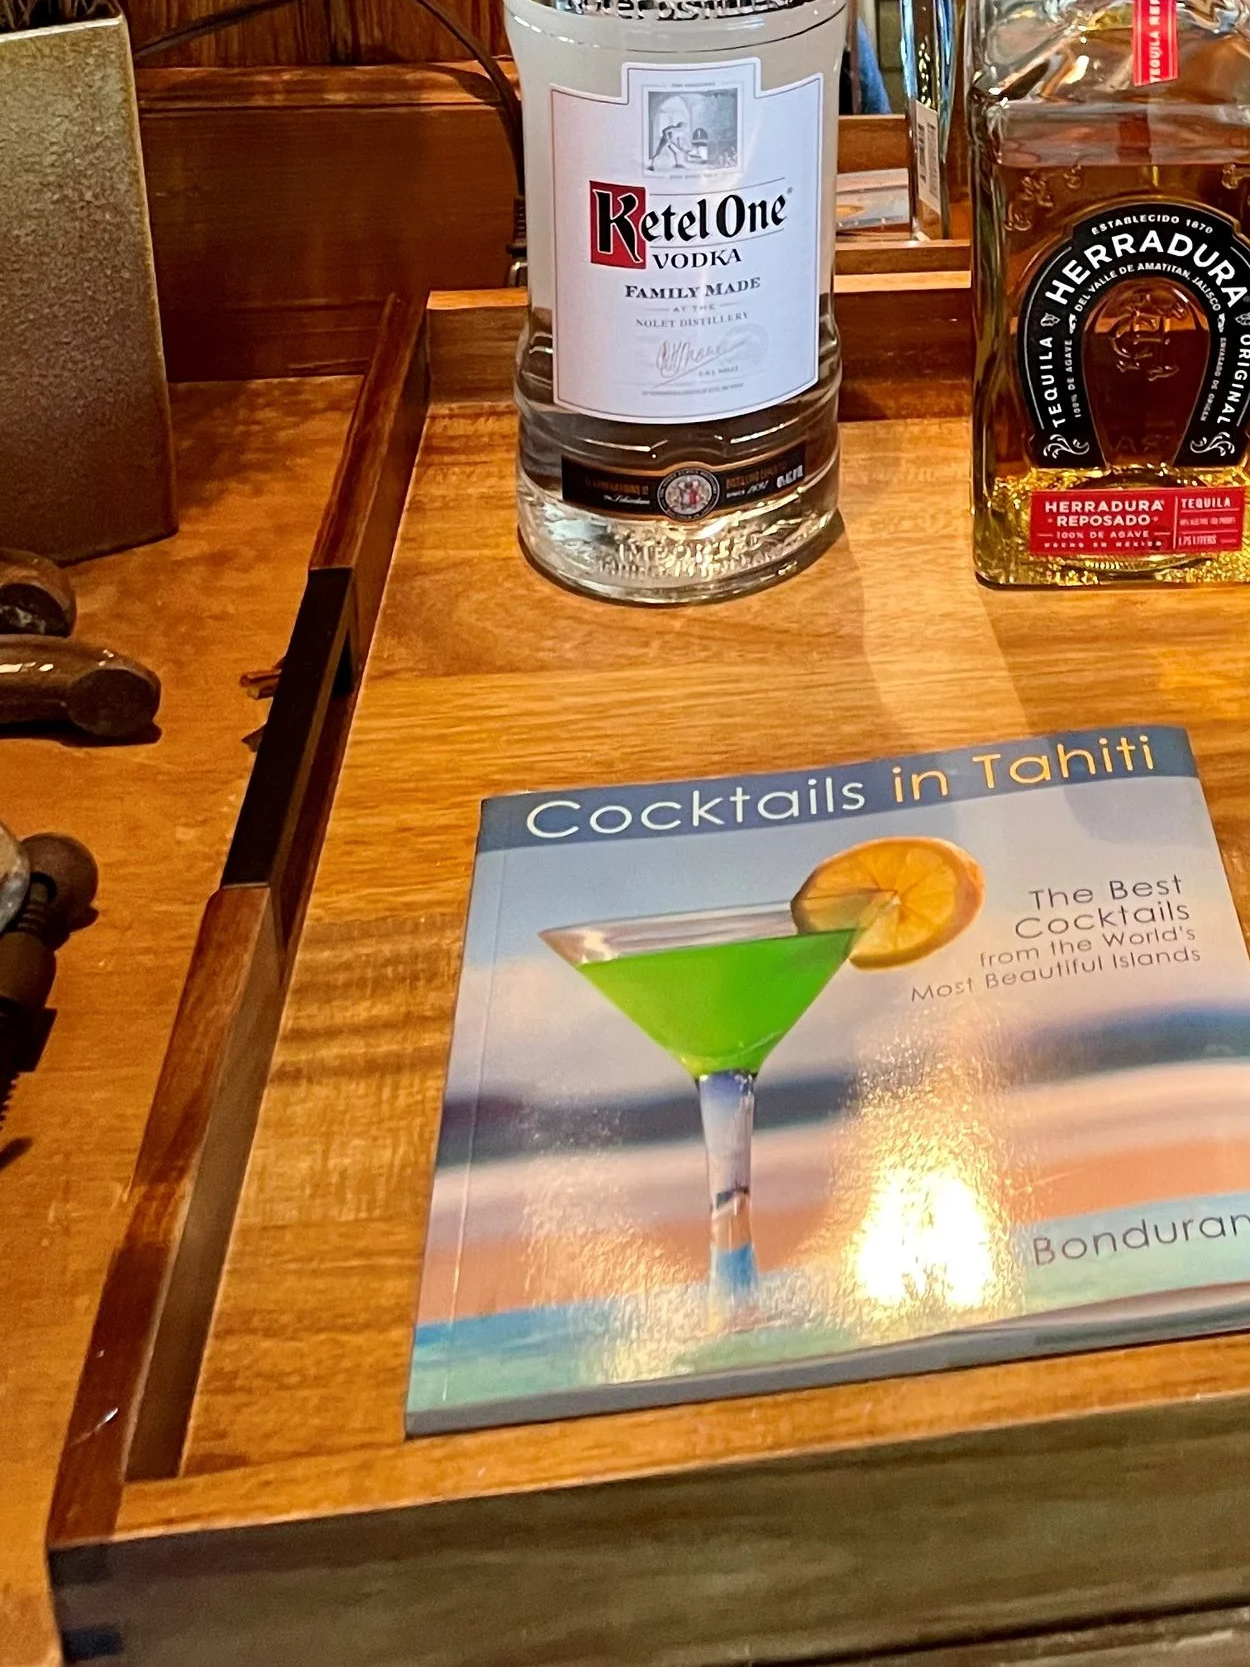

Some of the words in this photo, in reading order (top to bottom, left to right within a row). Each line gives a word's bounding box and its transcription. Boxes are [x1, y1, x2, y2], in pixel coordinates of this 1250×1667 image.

[1149, 33, 1163, 83] TEQUILA
[590, 188, 709, 265] Ketel
[715, 192, 789, 238] One
[1091, 214, 1180, 235] ESTABLECIDO
[1185, 218, 1214, 235] 1870
[653, 248, 743, 271] VODKA
[1045, 230, 1249, 308] HERRADURA
[625, 284, 701, 299] FAMILY
[705, 276, 761, 297] MADE
[1074, 289, 1091, 312] DEL
[1088, 269, 1118, 295] VALLE
[1119, 263, 1135, 276] DE
[1191, 274, 1222, 312] JALISCO
[636, 318, 676, 328] NOLET
[680, 311, 749, 327] DISTILLERY
[1064, 339, 1073, 373] AGAVE
[1039, 337, 1066, 429] TEQUILA
[1045, 500, 1164, 513] HERRADURA
[1056, 515, 1151, 527] REPOSADO
[1181, 497, 1231, 509] TEQUILA
[1089, 531, 1104, 539] DE
[1110, 530, 1149, 539] AGAVE
[527, 777, 866, 838] Cocktails
[892, 766, 949, 803] in
[971, 735, 1153, 789] Tahiti
[1028, 887, 1094, 910] The
[1109, 874, 1182, 901] Best
[1015, 901, 1190, 939] Cocktails
[979, 945, 1040, 968] from
[1050, 939, 1092, 956] the
[1102, 925, 1196, 948] World's
[911, 977, 973, 1002] Most
[985, 955, 1103, 989] Beautiful
[1112, 946, 1201, 968] Islands
